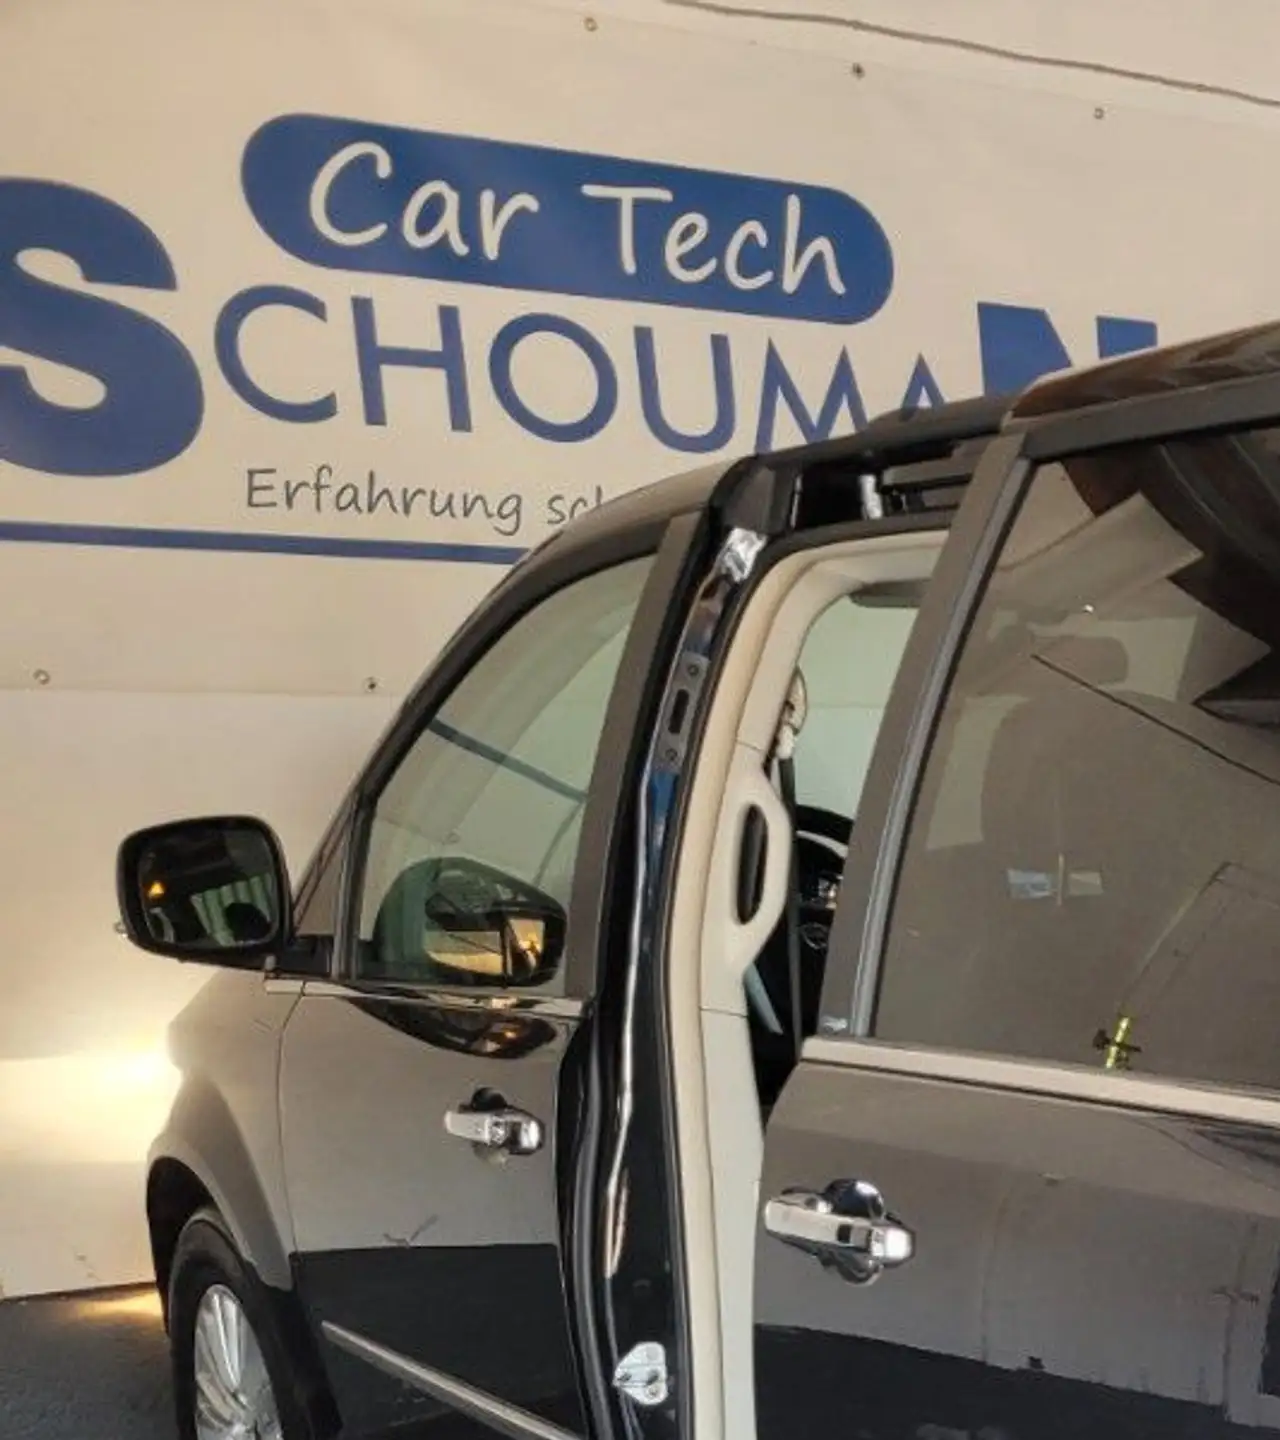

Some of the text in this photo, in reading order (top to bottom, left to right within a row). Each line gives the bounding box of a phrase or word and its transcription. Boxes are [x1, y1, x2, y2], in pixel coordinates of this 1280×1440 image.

[309, 141, 846, 295] Car Tech
[246, 464, 603, 536] Erfahrung sc
